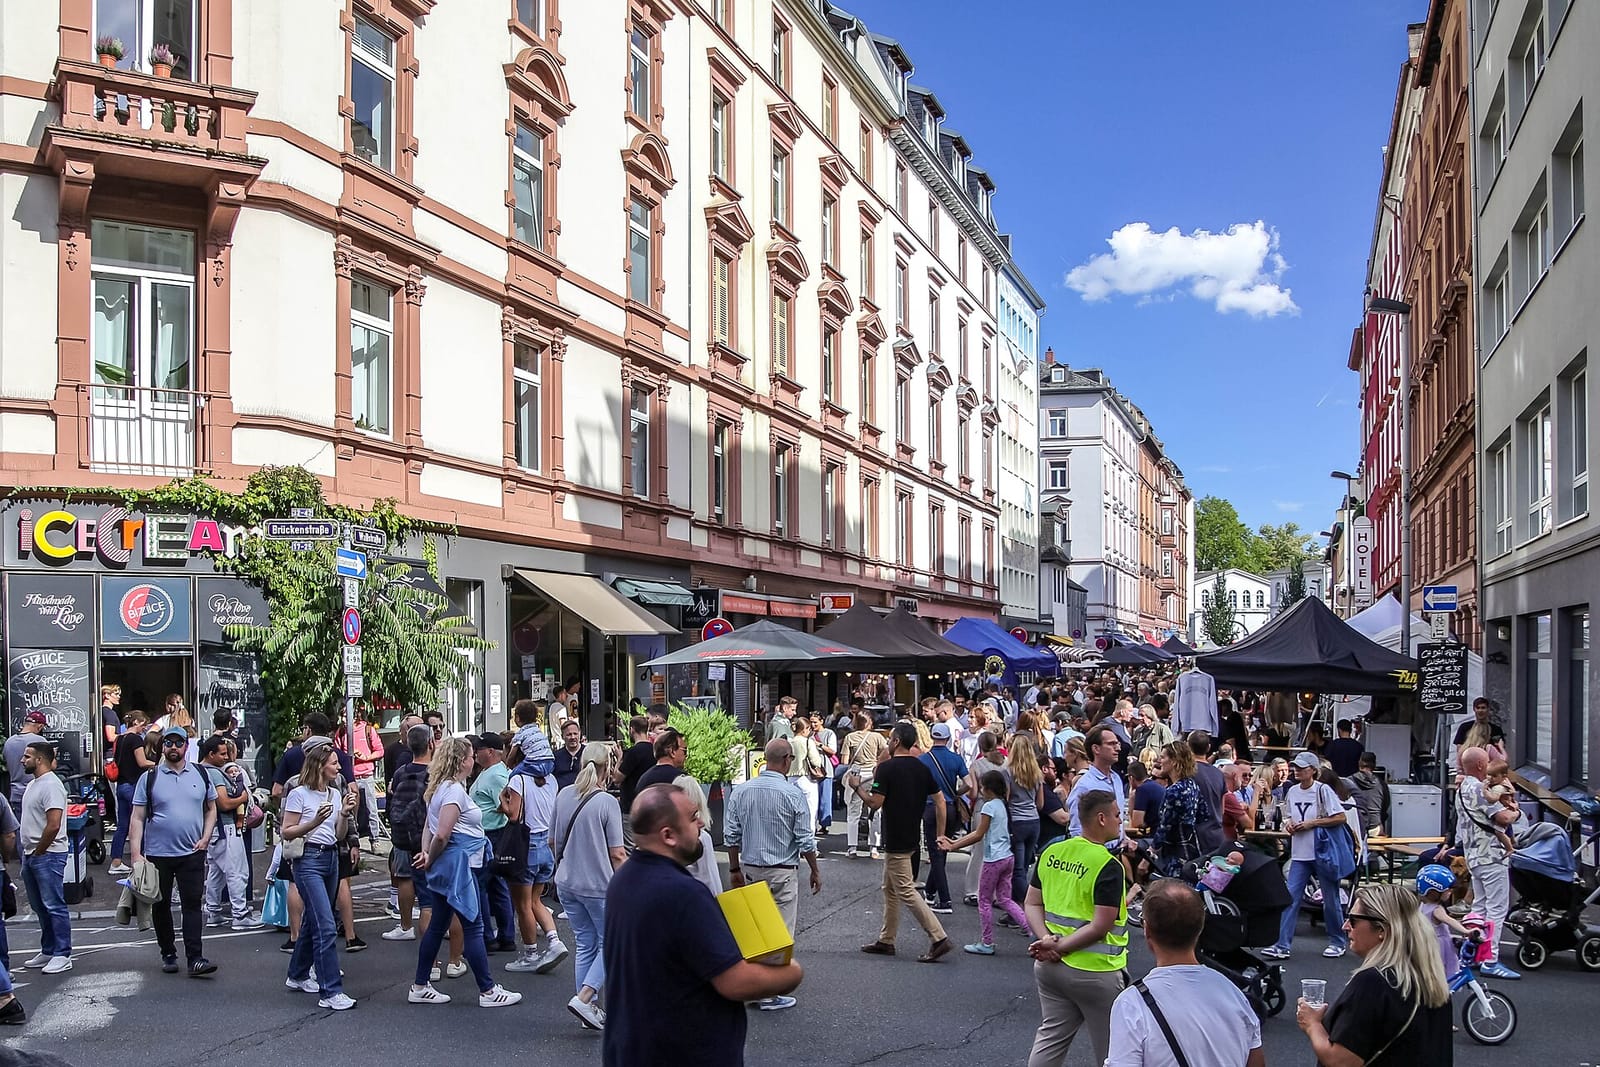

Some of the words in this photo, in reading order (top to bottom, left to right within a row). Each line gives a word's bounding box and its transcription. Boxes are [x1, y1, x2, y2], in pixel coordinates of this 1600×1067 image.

[272, 524, 330, 535] Brückenstraße
[1357, 533, 1369, 589] HOTEL
[208, 593, 232, 612] We
[228, 597, 252, 617] love
[51, 605, 85, 631] Love
[1295, 803, 1312, 821] Y
[1047, 854, 1089, 879] Security
[1424, 876, 1443, 890] woom
